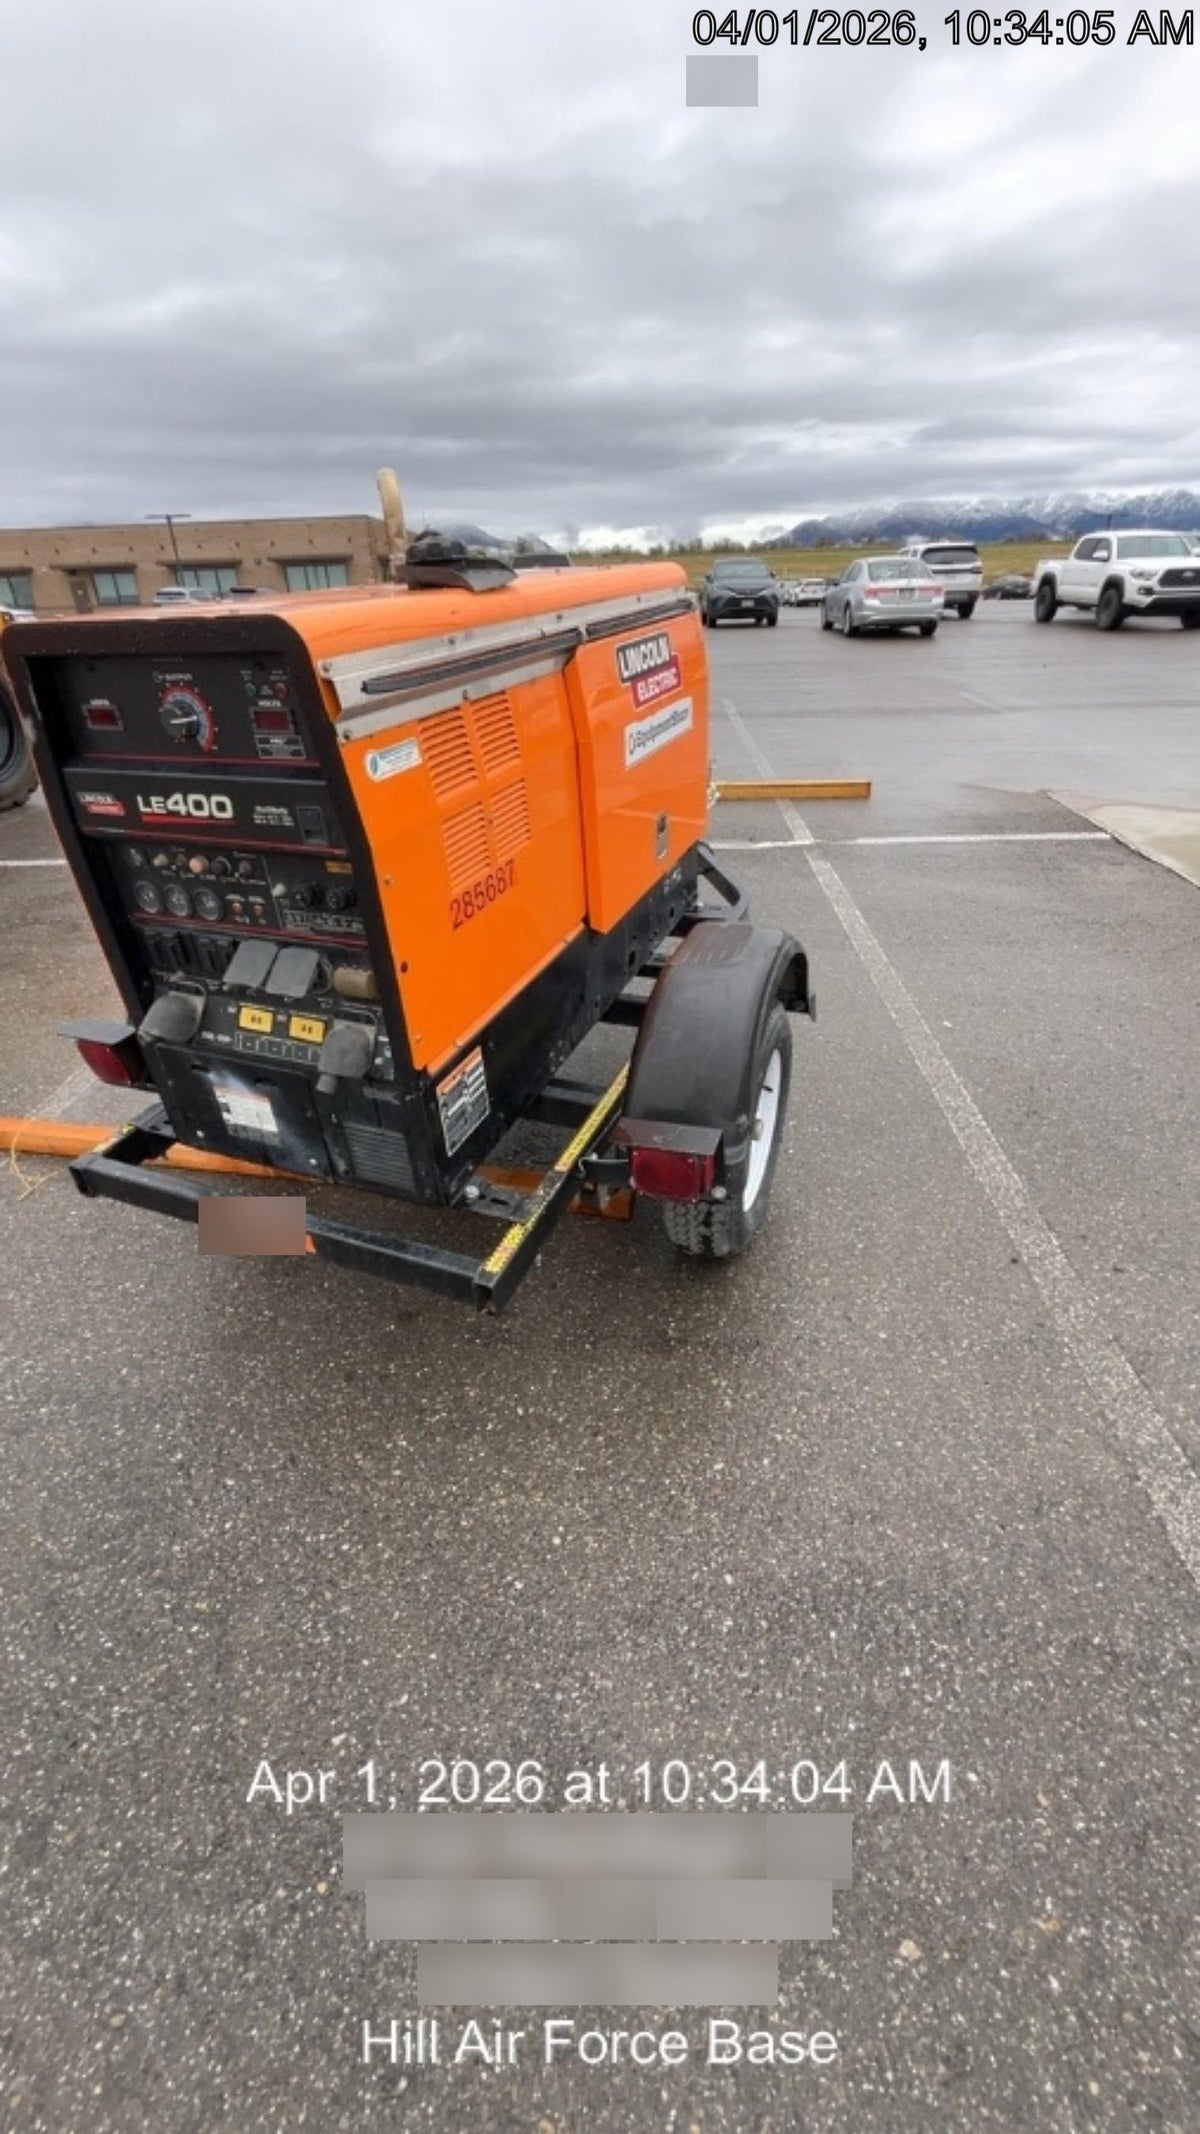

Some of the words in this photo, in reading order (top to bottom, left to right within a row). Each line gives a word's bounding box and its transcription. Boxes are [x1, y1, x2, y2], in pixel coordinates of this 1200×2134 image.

[618, 636, 670, 680] LINCOLN
[137, 791, 234, 819] LE400
[449, 857, 516, 930] 285687
